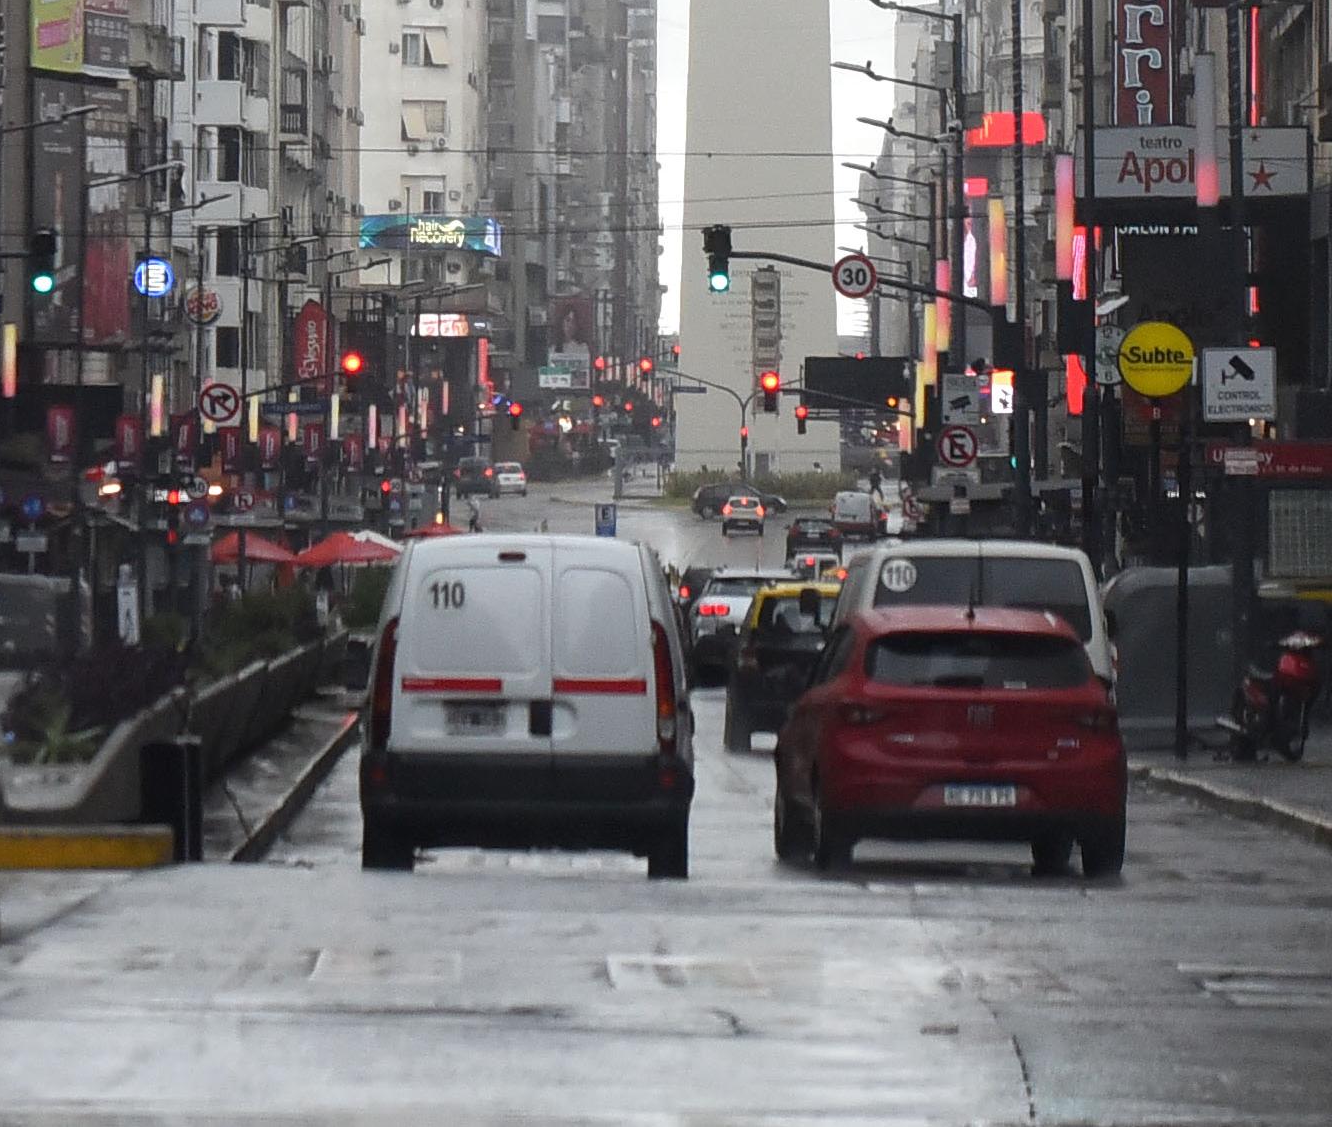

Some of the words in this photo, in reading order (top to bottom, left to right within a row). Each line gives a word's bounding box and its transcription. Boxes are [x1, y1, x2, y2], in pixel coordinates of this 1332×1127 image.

[1139, 135, 1183, 150] teatro
[841, 267, 868, 287] 30
[1128, 346, 1185, 364] Subte
[1218, 390, 1261, 401] CONTROL
[885, 564, 916, 583] 110
[429, 581, 465, 609] 110
